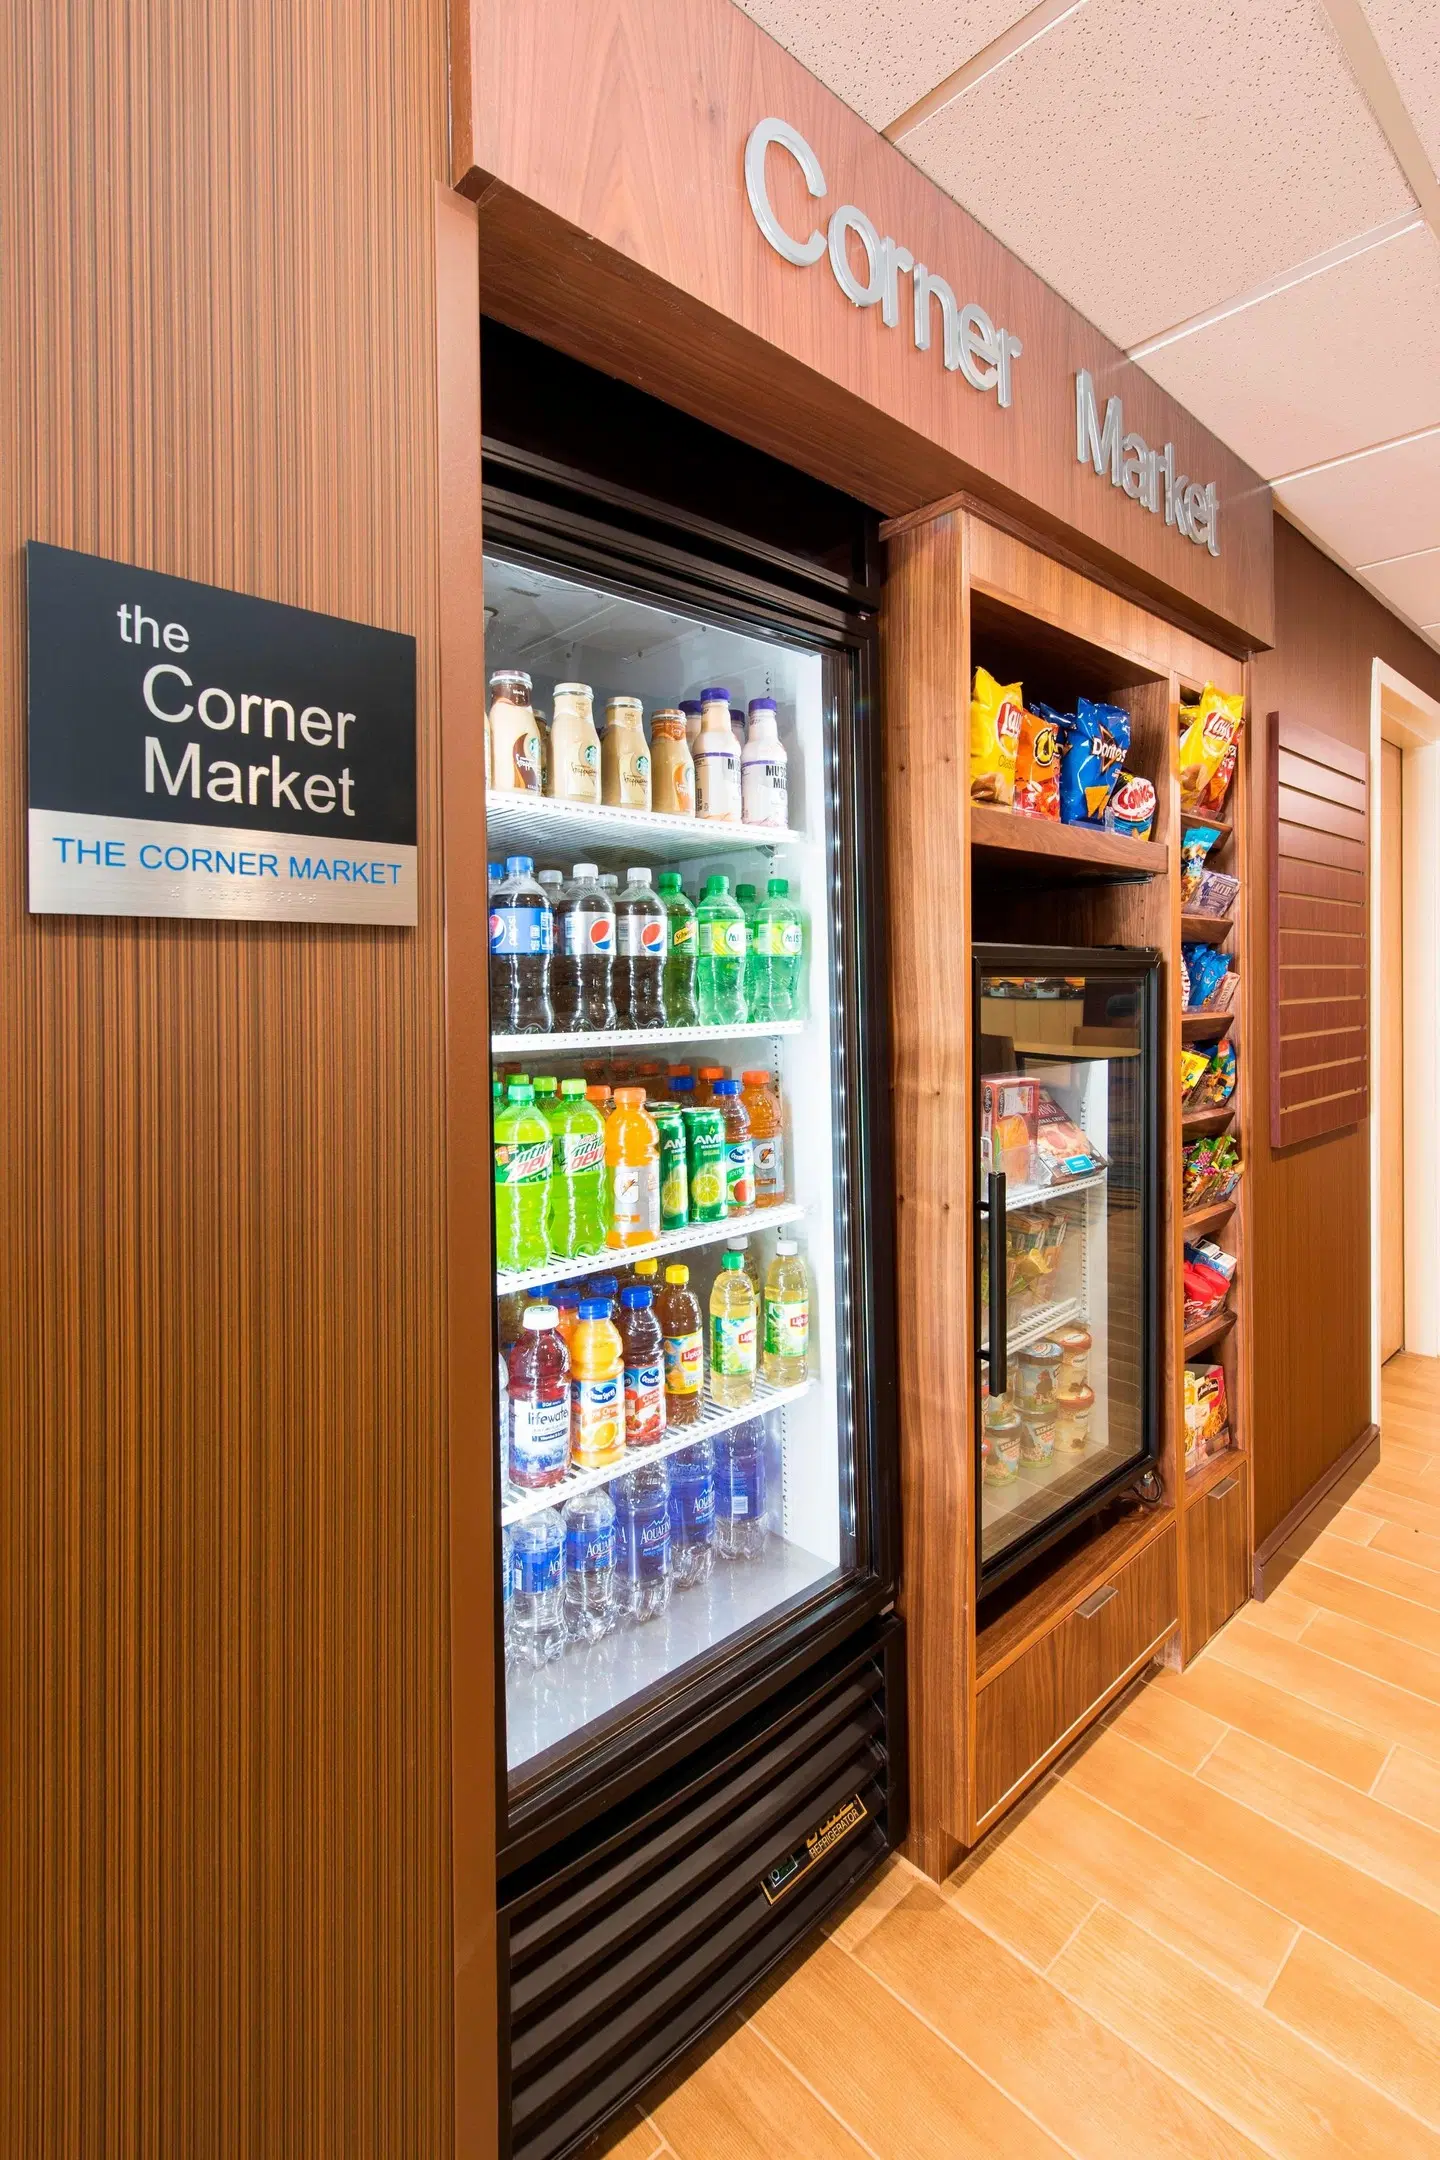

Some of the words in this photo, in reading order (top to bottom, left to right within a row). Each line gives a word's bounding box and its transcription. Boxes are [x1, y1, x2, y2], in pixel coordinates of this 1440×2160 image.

[744, 117, 1023, 408] Corner
[1075, 367, 1221, 557] Market
[117, 603, 190, 653] the
[143, 663, 356, 749] Corner
[144, 736, 355, 817] Market
[52, 836, 126, 867] THE
[139, 844, 279, 877] CORNER
[289, 856, 403, 885] MARKET
[528, 1408, 569, 1425] lifewate
[808, 1808, 860, 1859] REFRIGERATOR
